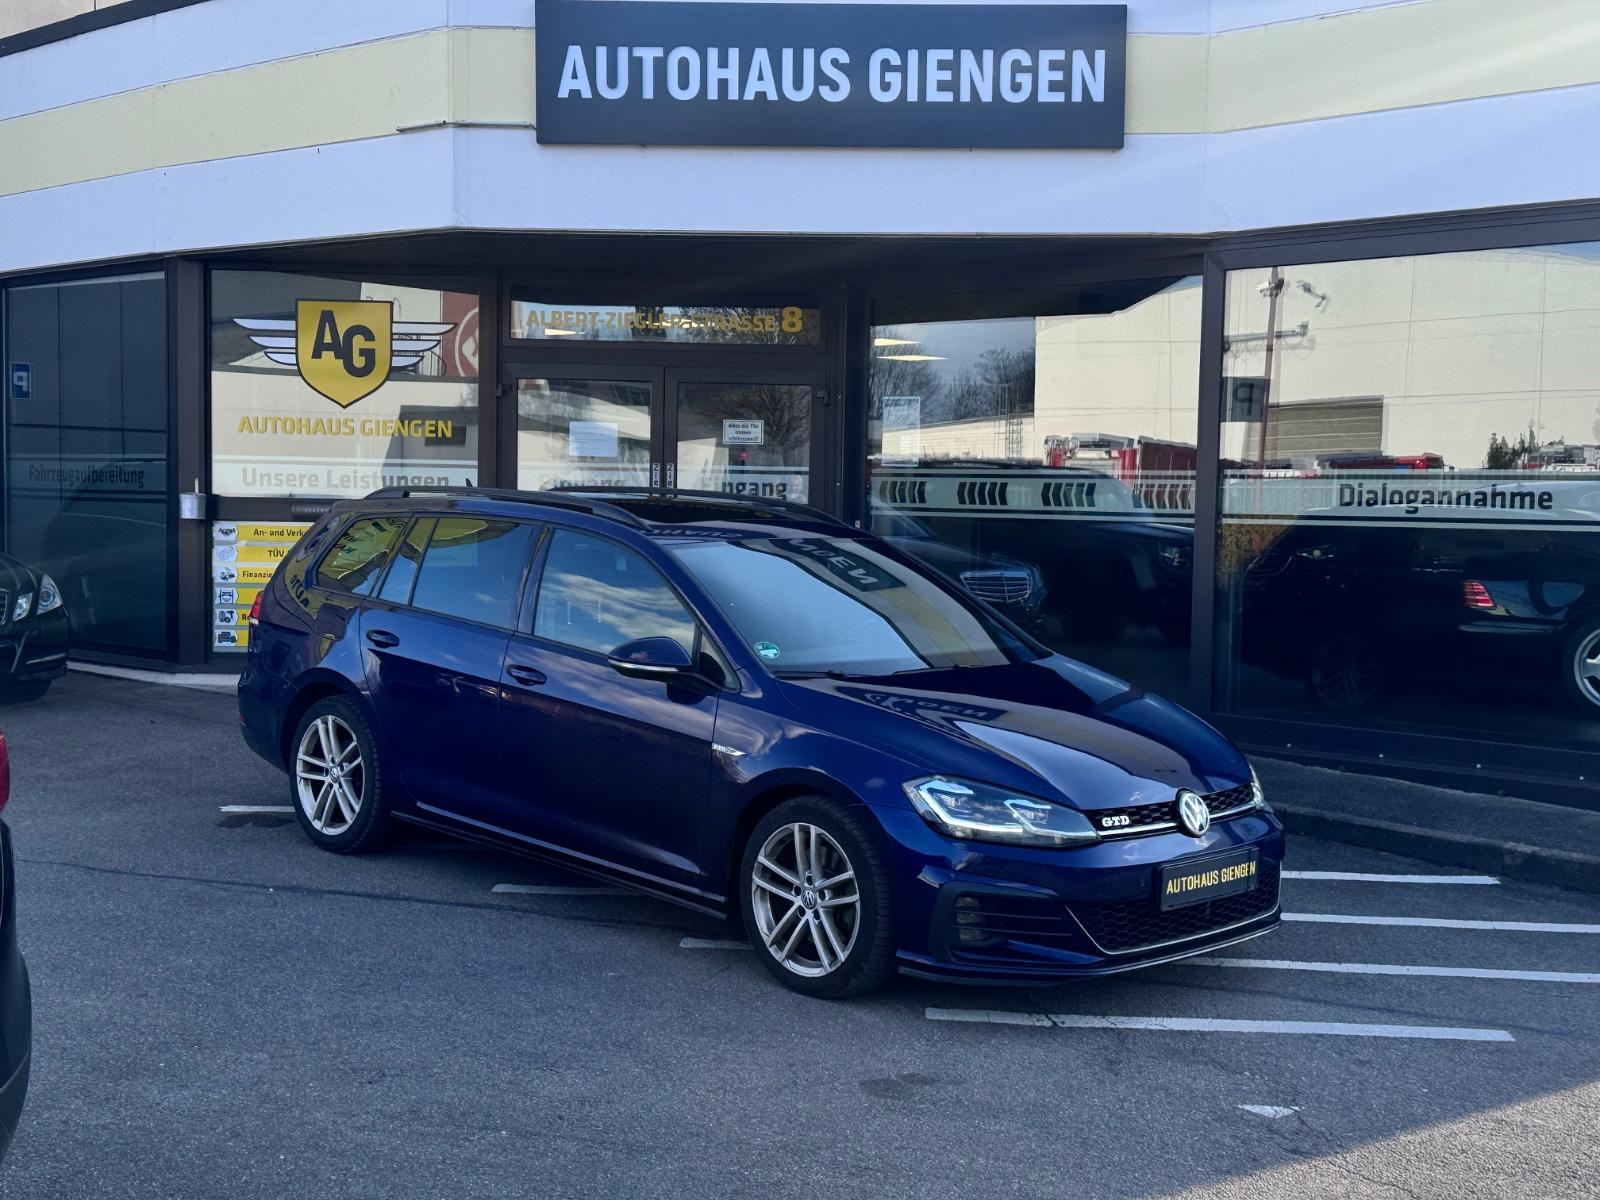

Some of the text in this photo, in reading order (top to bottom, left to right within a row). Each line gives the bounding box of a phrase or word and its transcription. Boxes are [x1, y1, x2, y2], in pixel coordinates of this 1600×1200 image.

[557, 45, 1107, 104] AUTOHAUS GIENGEN
[781, 306, 803, 333] 8
[310, 309, 377, 378] AG
[236, 415, 454, 439] AUTOHAUS GIENGEN
[28, 463, 145, 489] Fahrzeugaufbereitung
[241, 467, 449, 490] Unsere Leistungen
[1338, 482, 1553, 515] Dialogannahme
[269, 529, 285, 537] und
[267, 548, 285, 558] TÜV
[1101, 815, 1130, 828] GTD
[1165, 860, 1256, 895] AUTOHAUS GIENGEN
